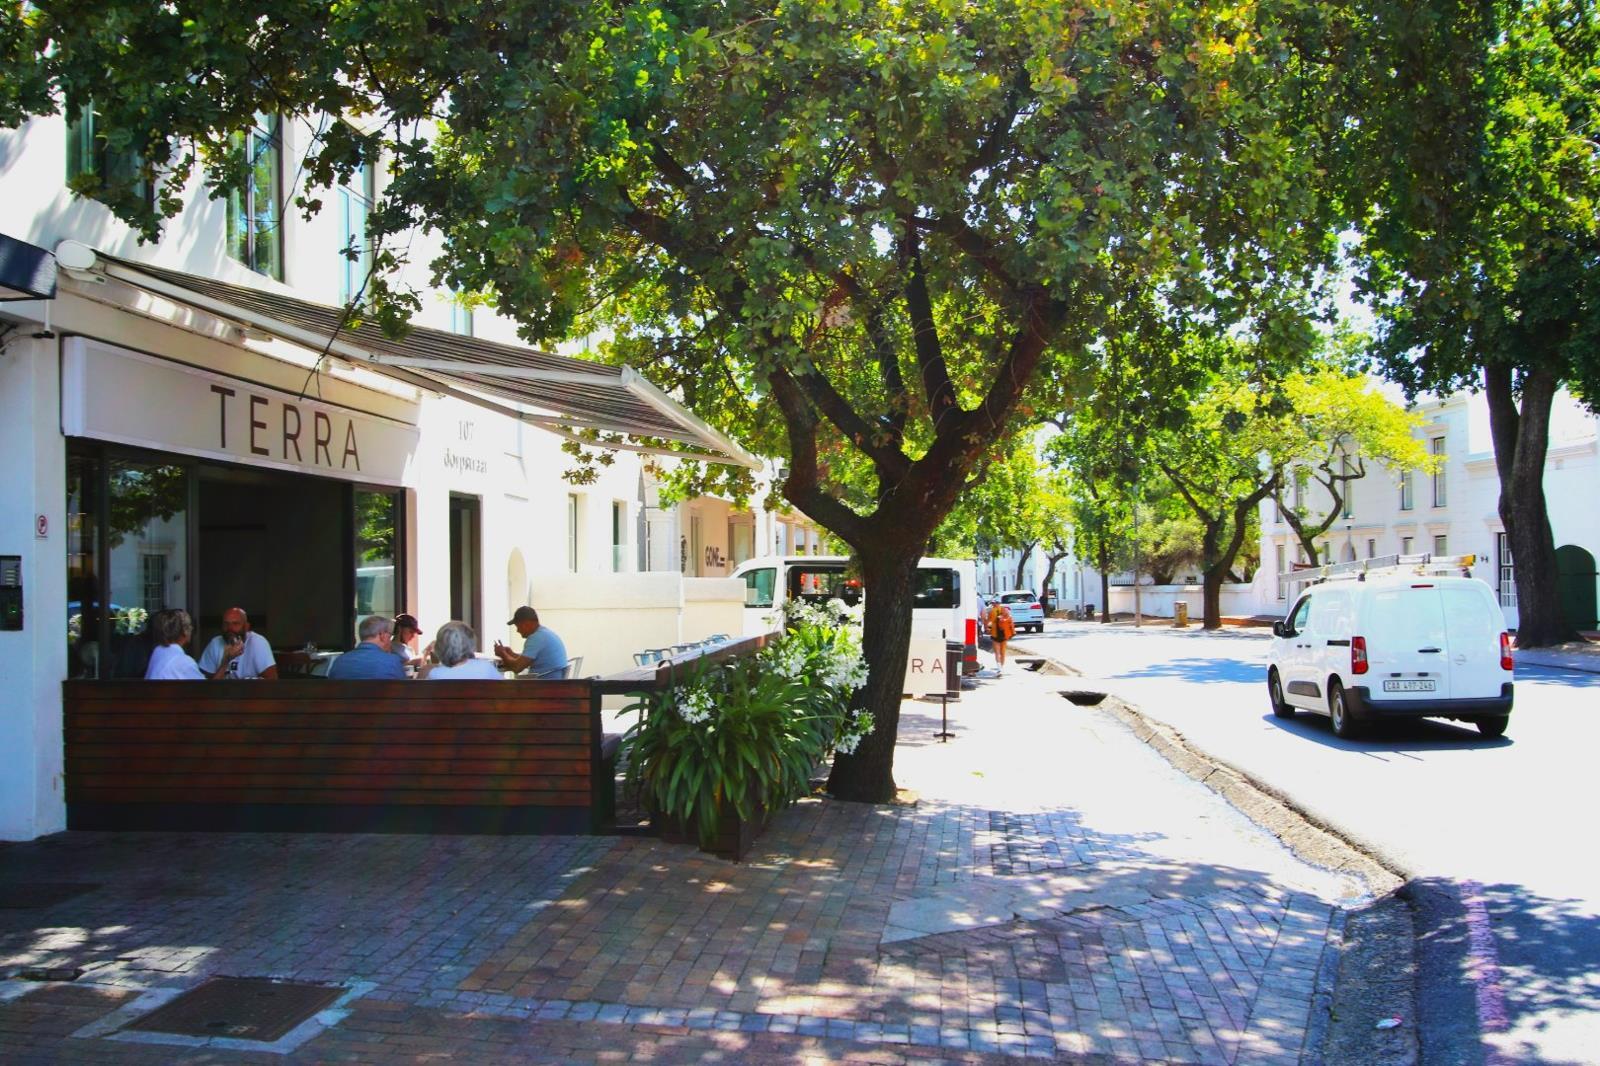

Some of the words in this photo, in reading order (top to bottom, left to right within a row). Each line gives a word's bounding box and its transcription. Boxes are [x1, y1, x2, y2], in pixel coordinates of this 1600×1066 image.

[210, 384, 361, 472] TERRA
[458, 420, 474, 440] 107
[911, 658, 944, 674] RA
